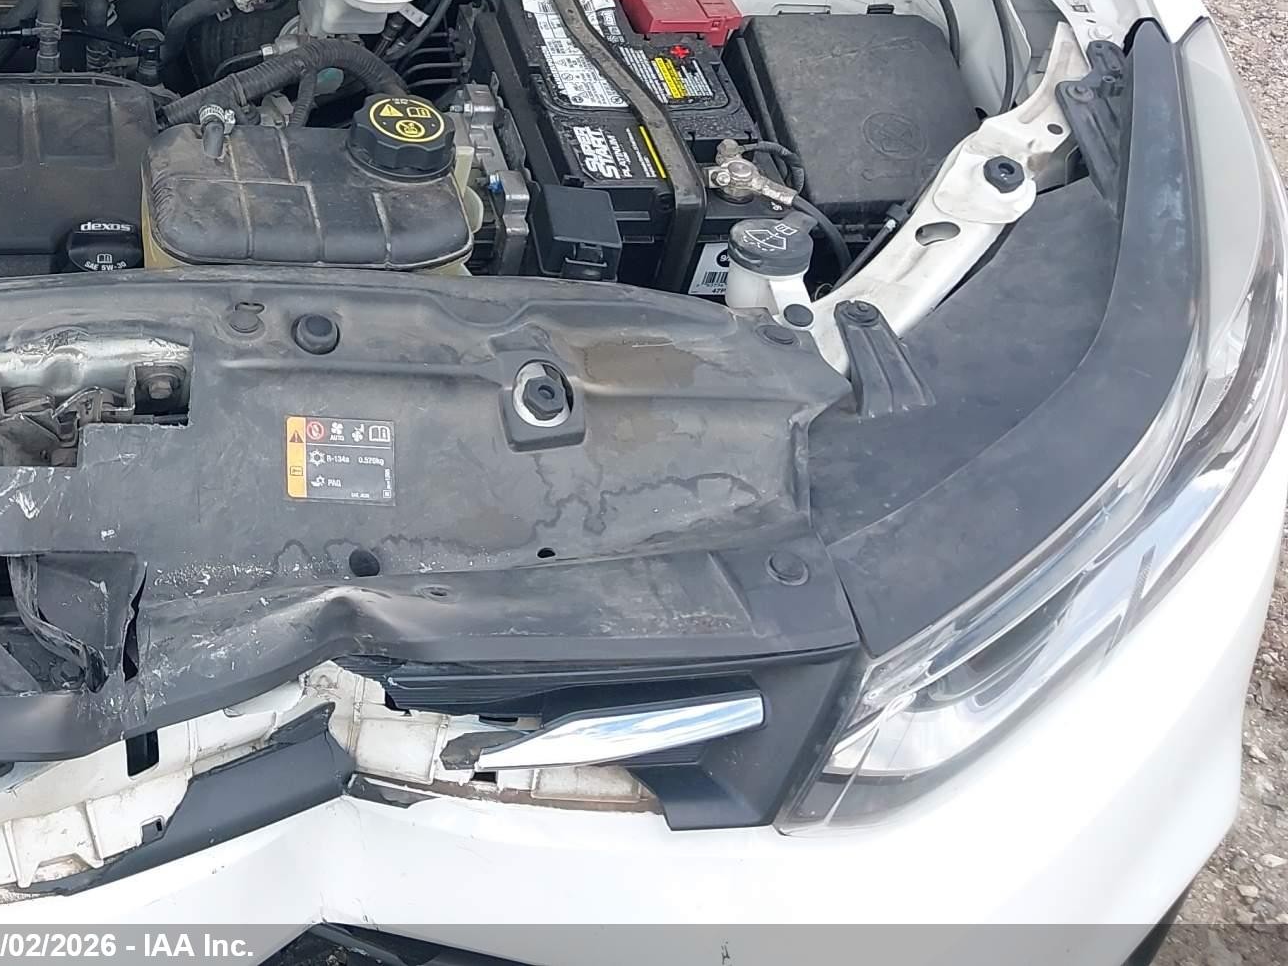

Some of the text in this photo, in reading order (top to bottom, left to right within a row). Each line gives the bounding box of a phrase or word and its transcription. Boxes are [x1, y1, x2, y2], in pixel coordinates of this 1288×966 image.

[573, 126, 598, 172] SUPER
[585, 125, 621, 179] START
[607, 135, 632, 178] PLATINUM
[80, 221, 132, 232] dexos
[84, 261, 127, 271] SAE 5W-30
[326, 454, 350, 463] R-134a
